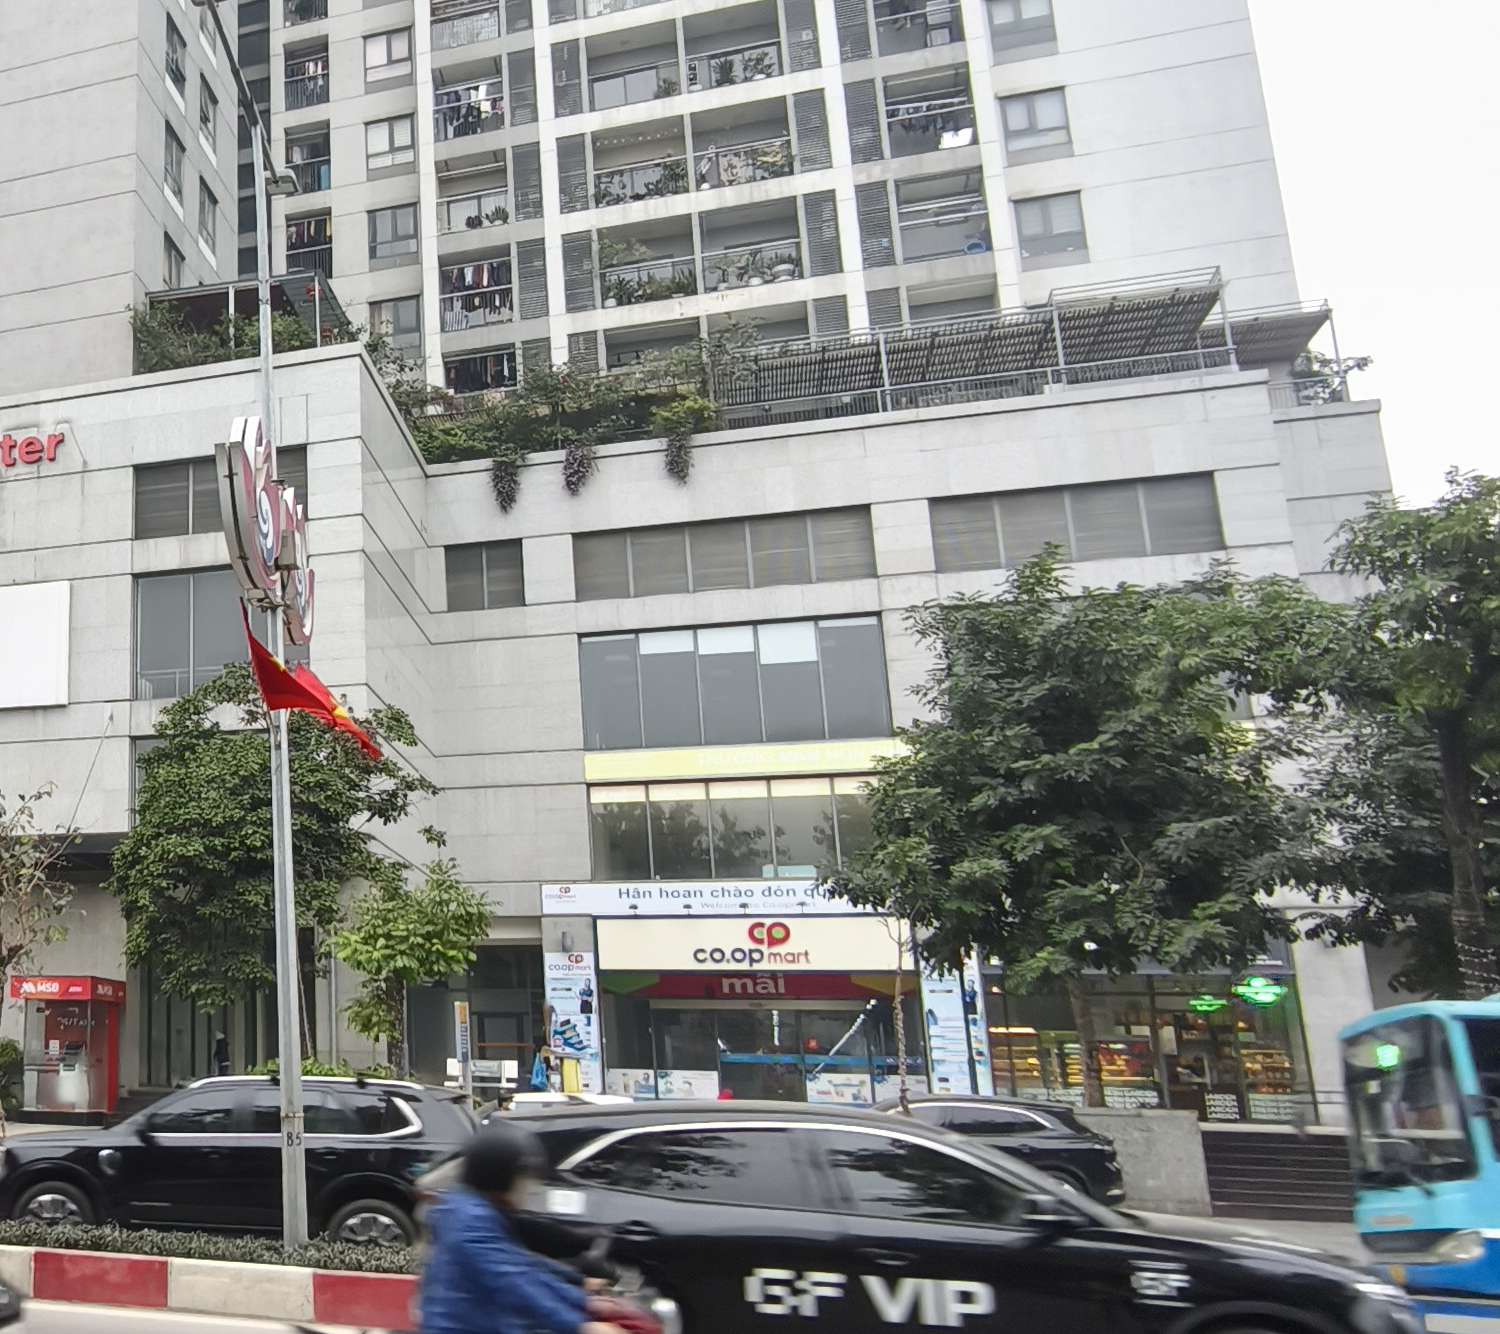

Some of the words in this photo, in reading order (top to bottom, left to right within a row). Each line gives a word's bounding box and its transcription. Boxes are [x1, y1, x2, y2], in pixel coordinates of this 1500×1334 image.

[618, 886, 652, 899] Hân
[659, 886, 703, 899] hoan
[710, 886, 754, 898] chào
[743, 1268, 848, 1317] GF
[859, 1275, 998, 1327] VIP
